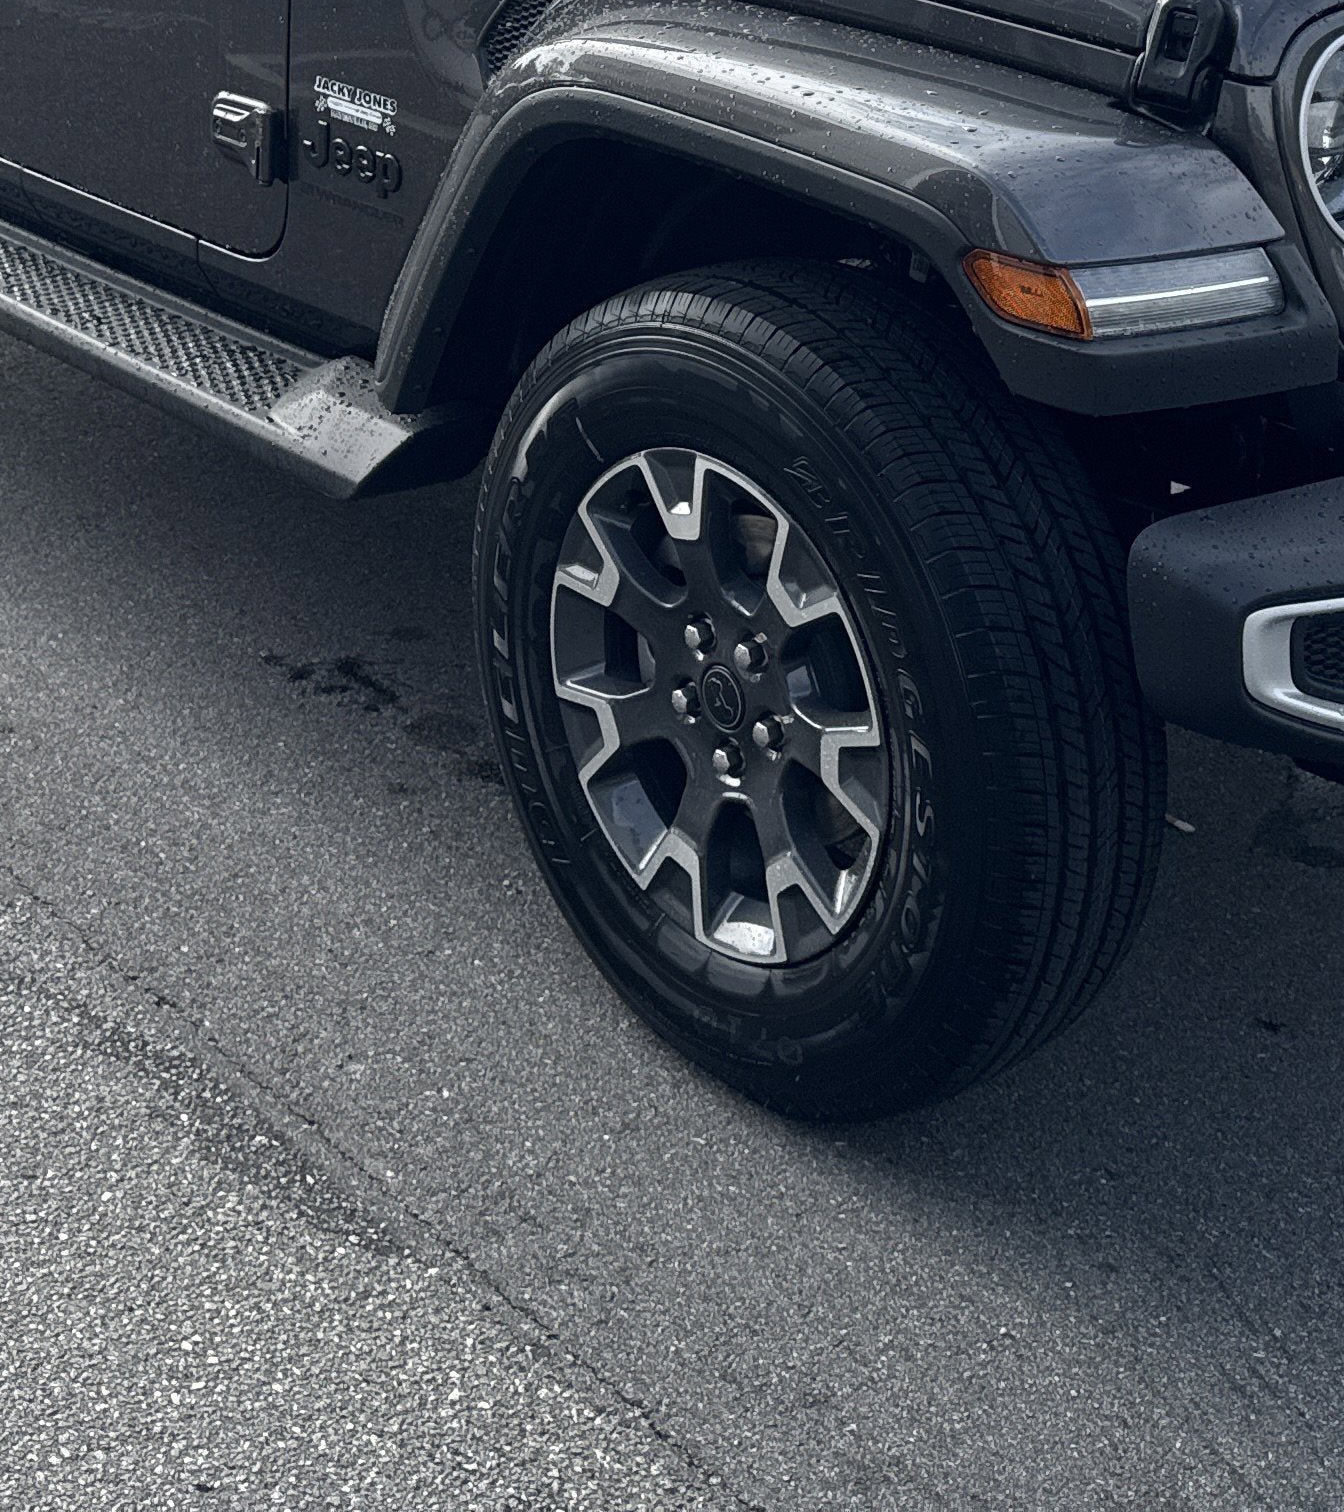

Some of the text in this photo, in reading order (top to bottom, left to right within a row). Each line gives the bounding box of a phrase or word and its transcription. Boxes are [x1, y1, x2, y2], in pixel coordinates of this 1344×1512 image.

[314, 75, 354, 101] JACKY
[354, 88, 397, 115] JONES
[302, 119, 403, 199] Jeep
[788, 454, 938, 1016] BRIDGESTONE
